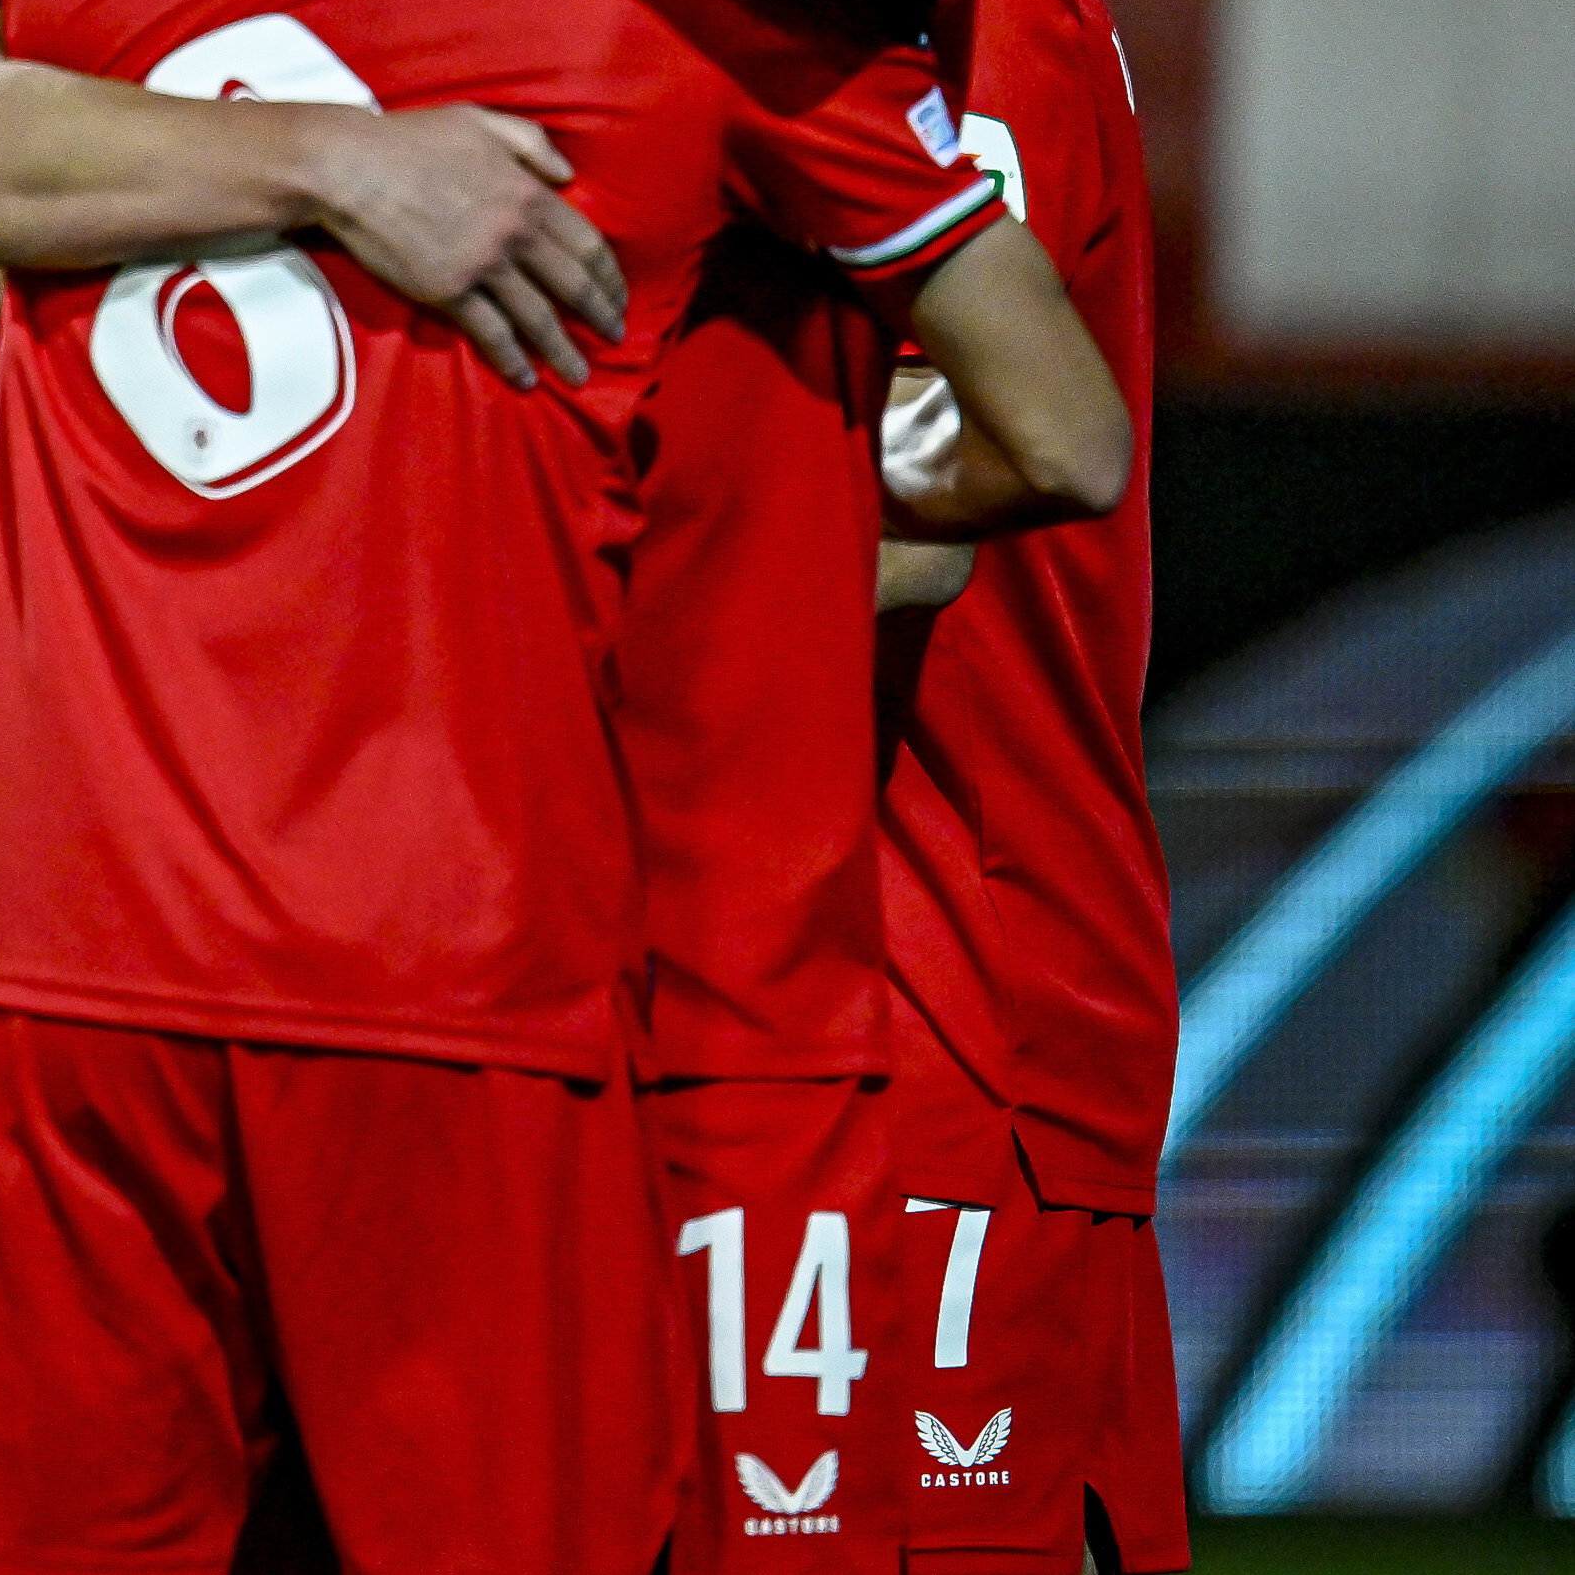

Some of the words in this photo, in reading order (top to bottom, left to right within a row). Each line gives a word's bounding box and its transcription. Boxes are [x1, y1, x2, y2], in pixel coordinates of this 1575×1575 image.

[676, 1206, 869, 1416] 14
[904, 1197, 992, 1369] 7
[920, 1469, 1011, 1489] CASTORE
